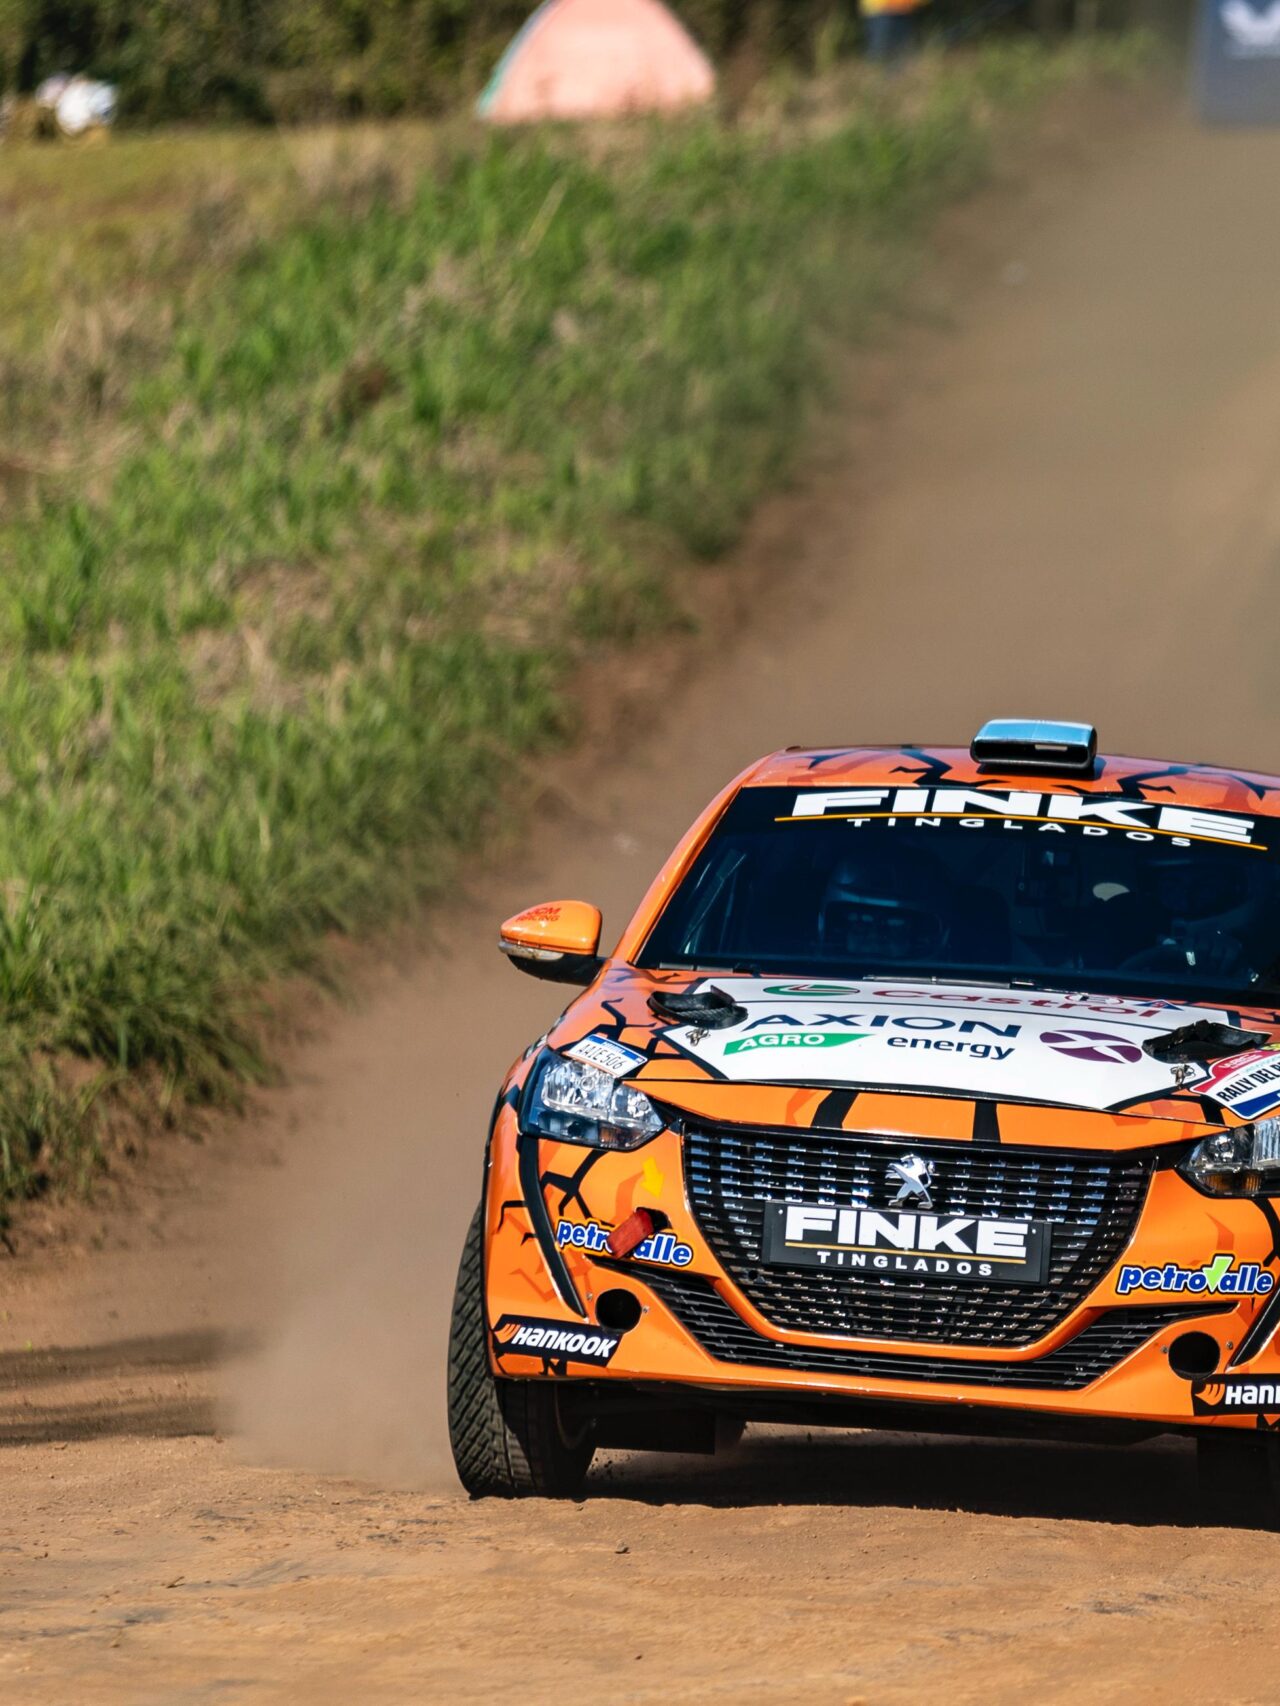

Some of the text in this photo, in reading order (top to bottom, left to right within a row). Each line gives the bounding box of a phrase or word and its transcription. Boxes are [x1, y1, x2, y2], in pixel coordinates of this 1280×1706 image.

[791, 788, 1255, 844] FINKE
[847, 817, 1191, 847] TINGLADOS
[872, 989, 1160, 1018] Castrol
[741, 1013, 1022, 1038] AXION
[738, 1033, 826, 1050] AGRO
[886, 1036, 1015, 1060] energy
[1215, 1076, 1258, 1102] RALLY
[1249, 1068, 1279, 1085] DEL
[557, 1221, 693, 1266] petralle
[784, 1206, 1029, 1258] FINKE
[817, 1251, 993, 1276] TINGLADOS
